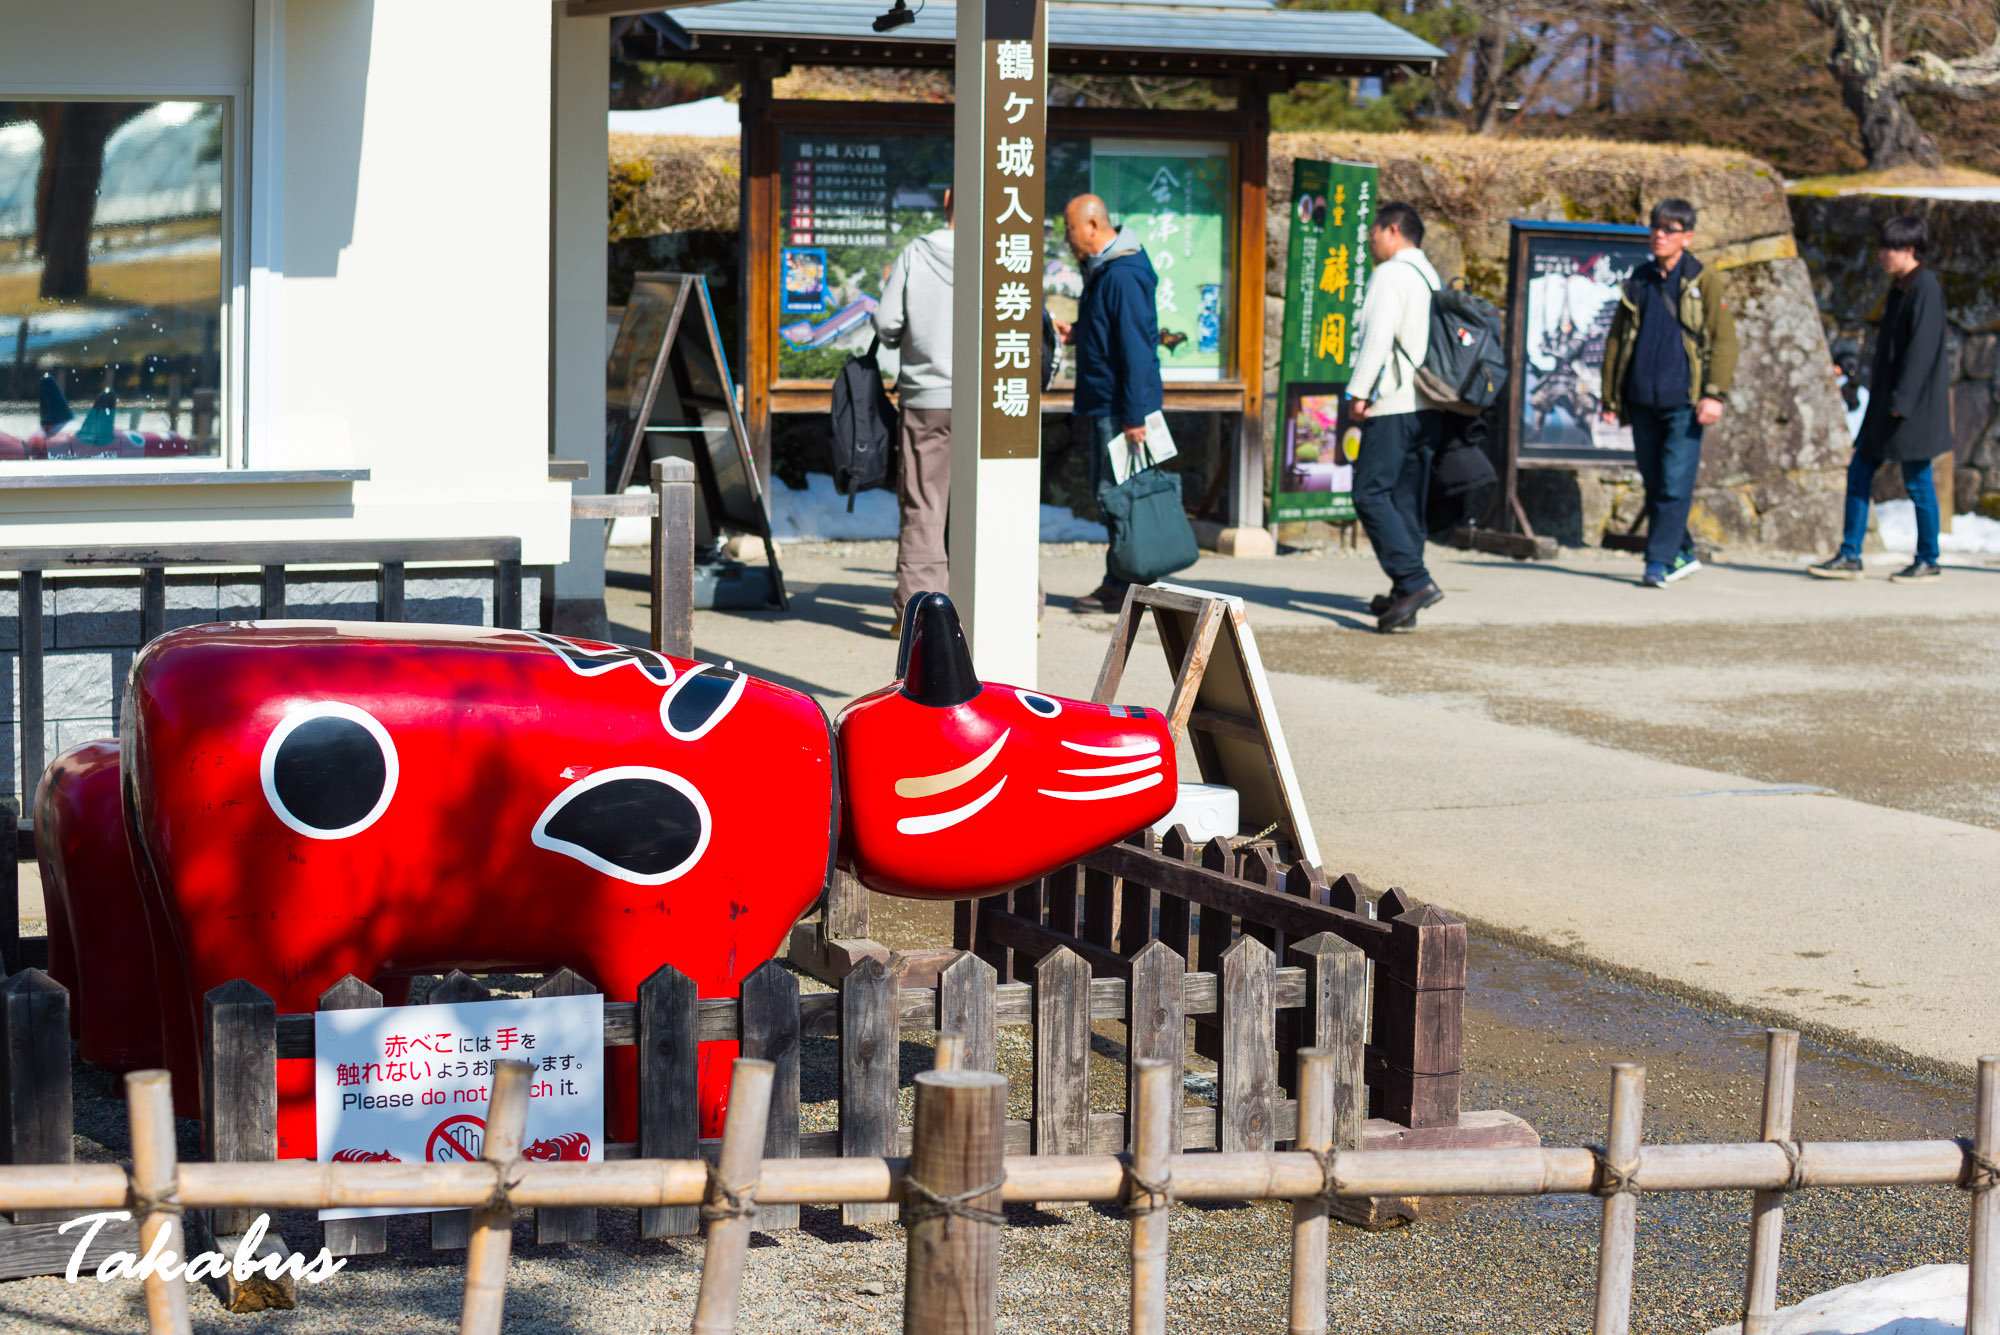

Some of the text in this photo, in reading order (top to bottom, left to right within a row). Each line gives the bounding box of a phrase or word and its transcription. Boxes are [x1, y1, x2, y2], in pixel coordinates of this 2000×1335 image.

[992, 39, 1035, 418] 鶴ヶ城入場券売場
[336, 1054, 583, 1087] 触れないようおします。
[343, 1093, 414, 1111] Please
[421, 1088, 446, 1105] do
[454, 1085, 488, 1104] not
[560, 1079, 578, 1096] it.
